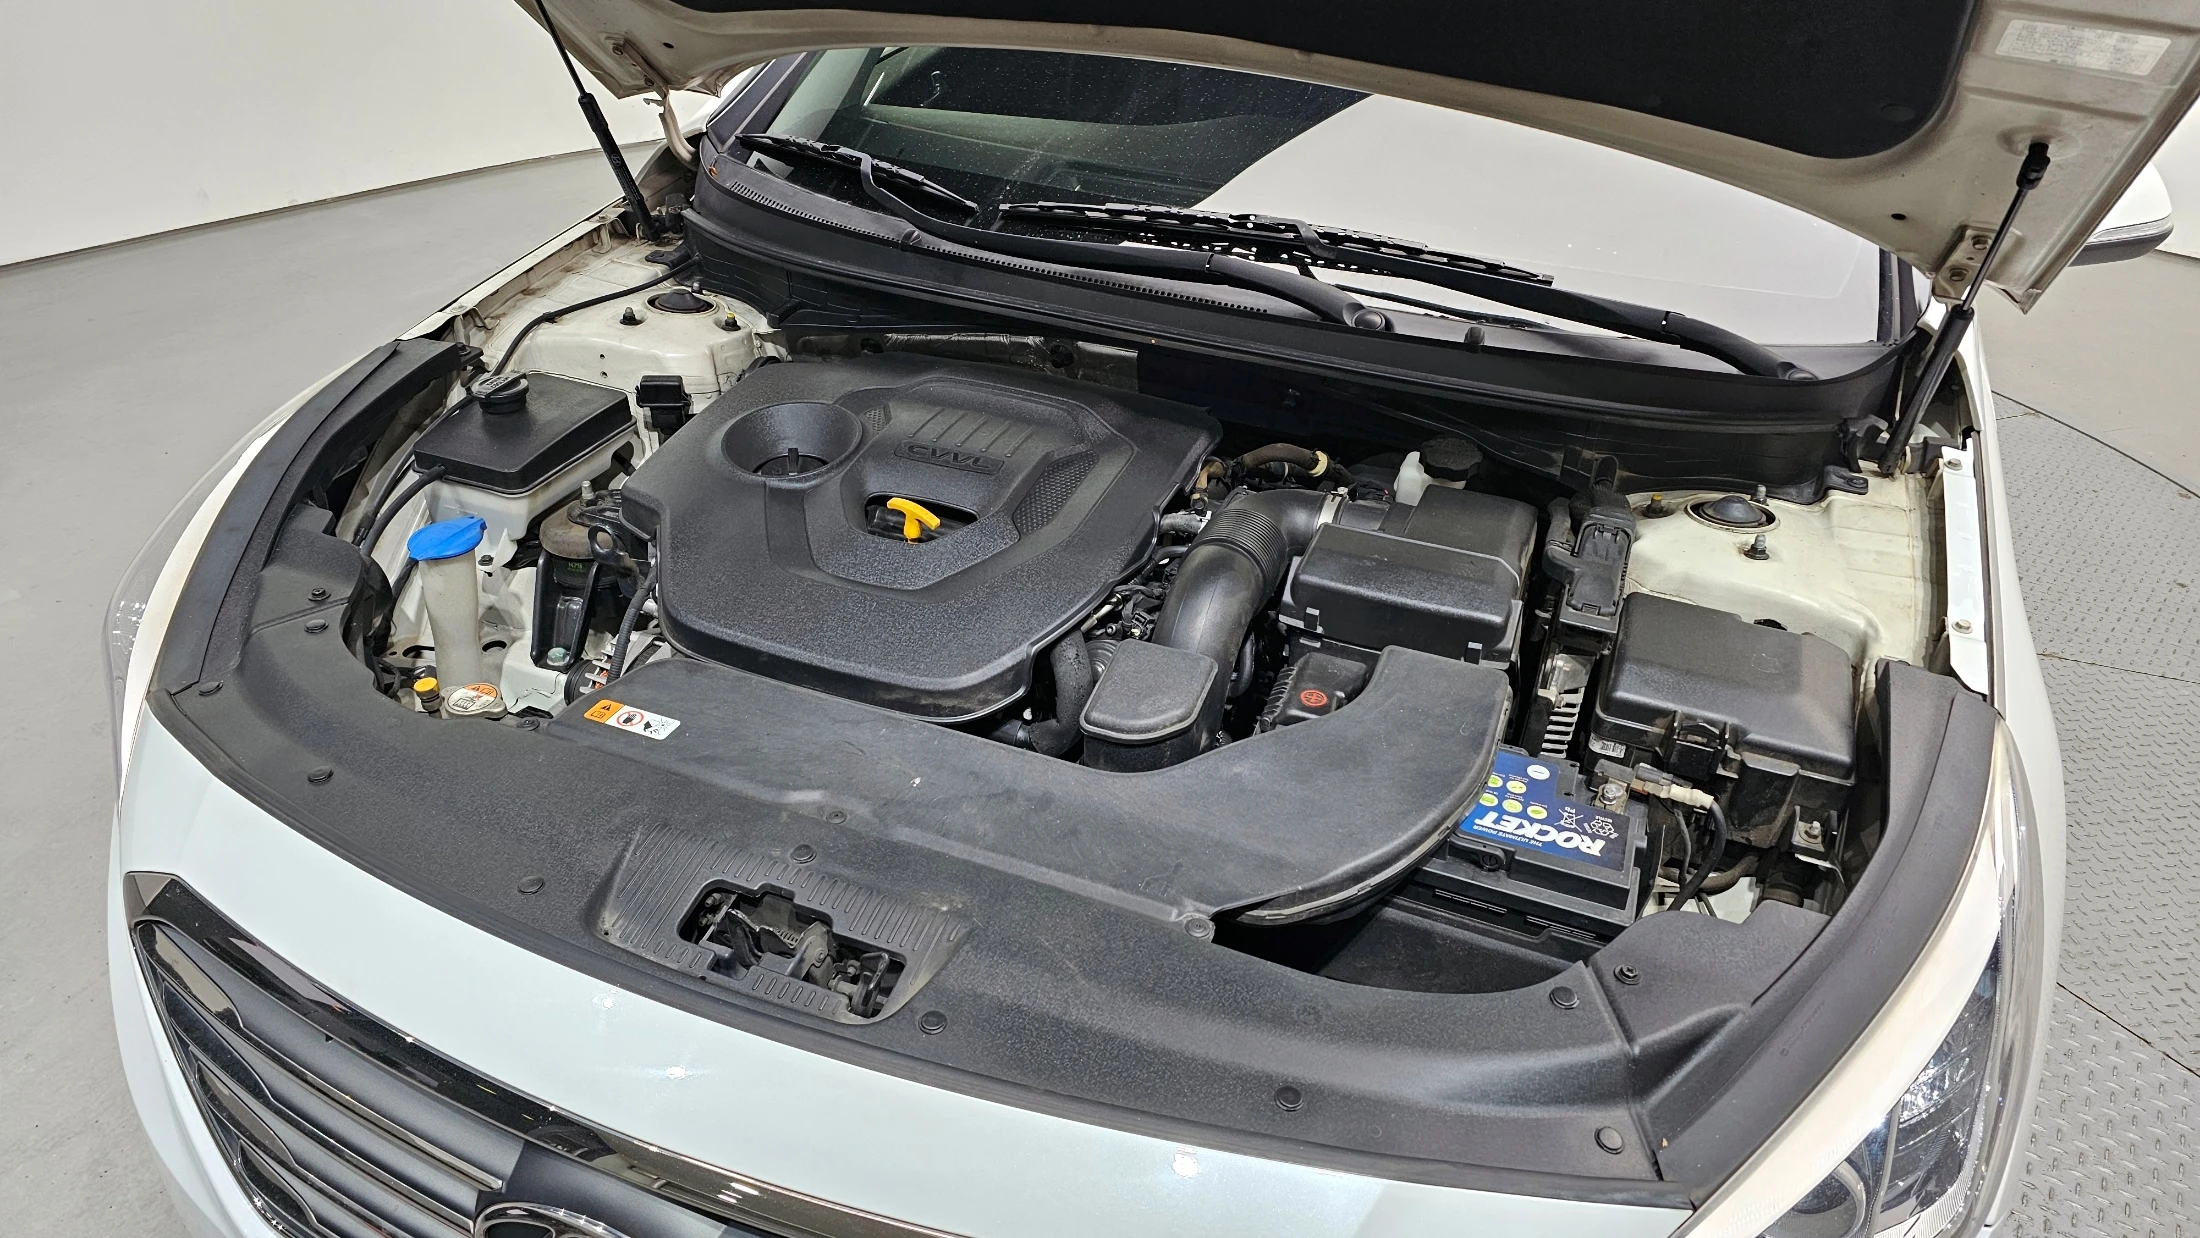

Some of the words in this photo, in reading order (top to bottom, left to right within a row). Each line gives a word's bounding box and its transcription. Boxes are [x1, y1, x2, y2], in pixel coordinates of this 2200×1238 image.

[907, 444, 991, 470] CVVL
[1564, 806, 1576, 815] Pb
[1595, 815, 1613, 823] RECYCLE
[1472, 824, 1499, 836] POWER
[1474, 810, 1607, 857] ROCKET
[1499, 831, 1529, 844] ULTIMATE
[1529, 839, 1543, 847] THE
